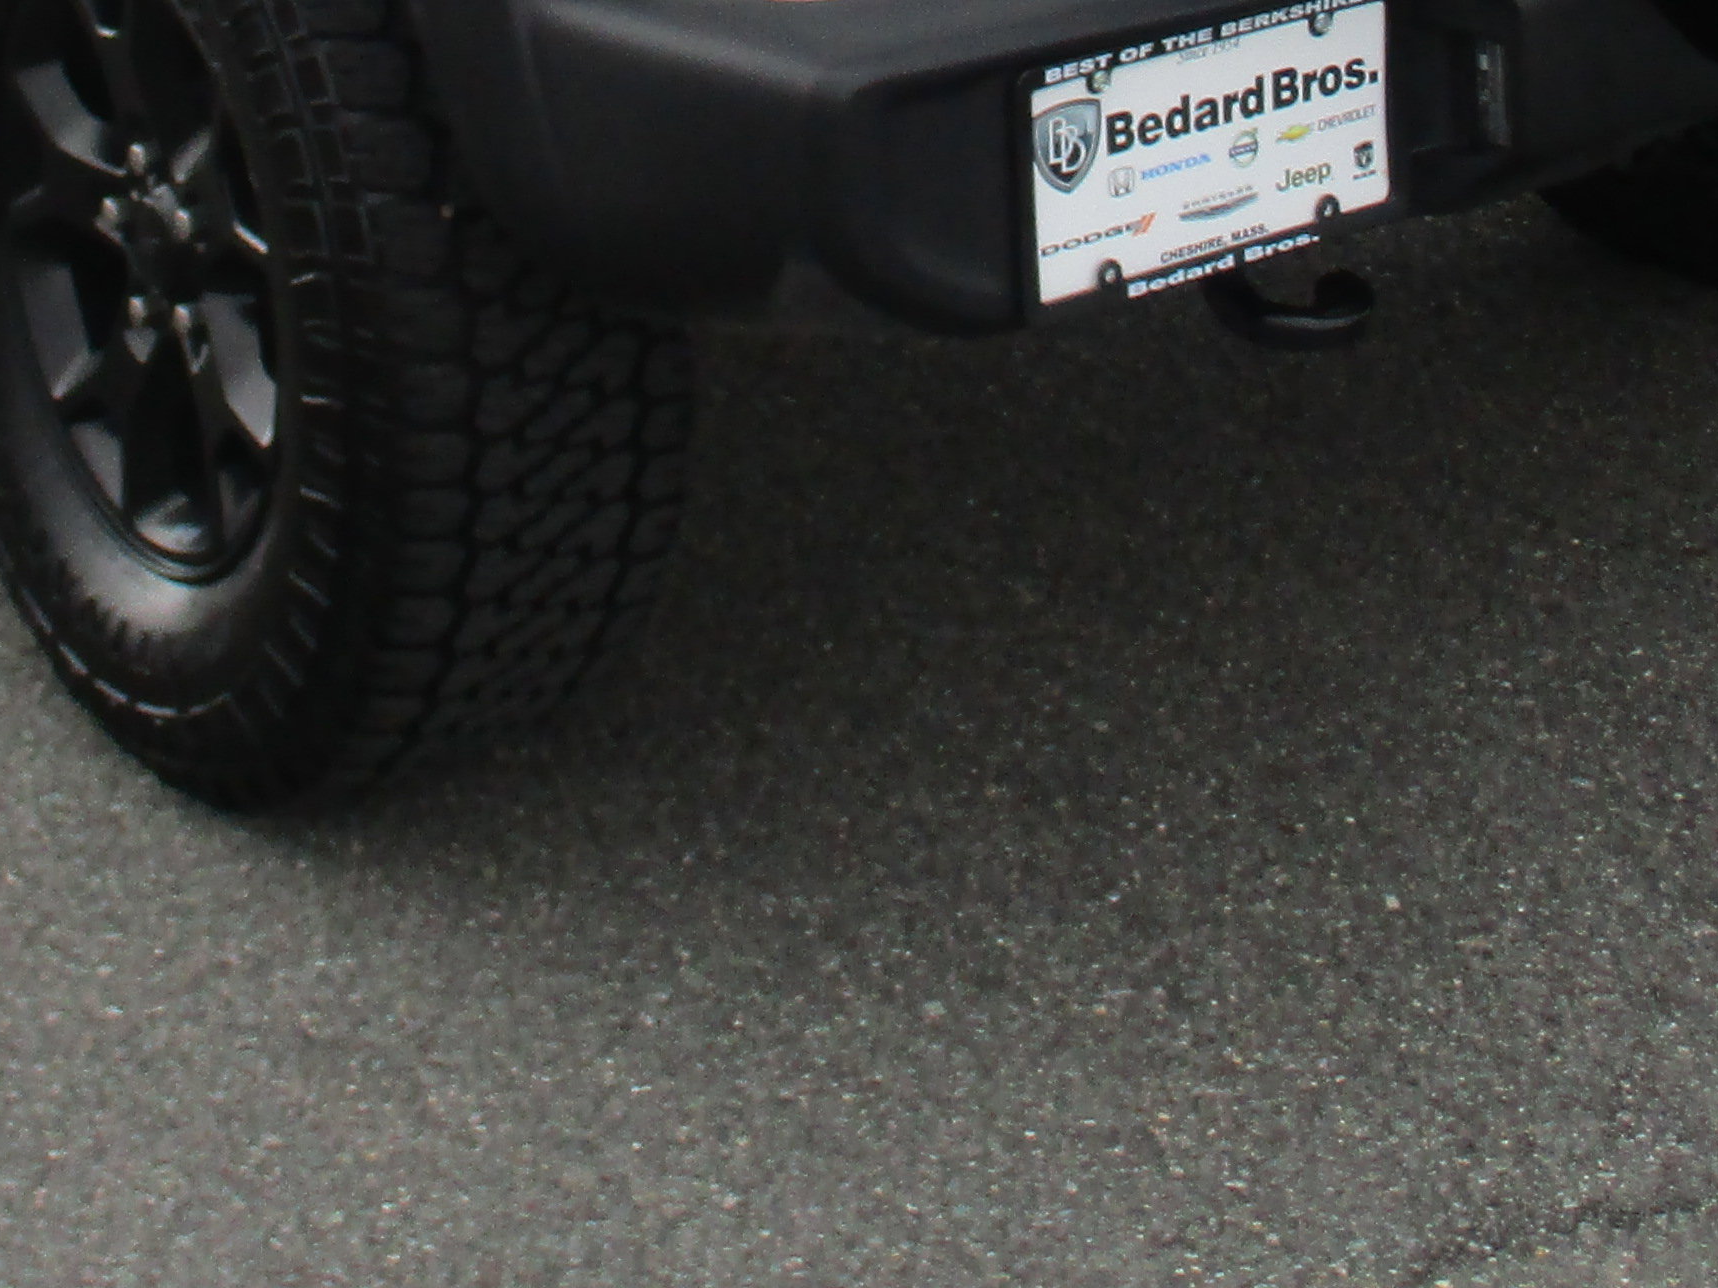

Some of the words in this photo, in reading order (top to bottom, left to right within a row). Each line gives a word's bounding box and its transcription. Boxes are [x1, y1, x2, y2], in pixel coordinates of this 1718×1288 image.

[1044, 55, 1112, 84] BEST
[1119, 41, 1153, 63] OF
[1163, 26, 1213, 53] THE
[1141, 152, 1212, 180] HONDA
[1275, 161, 1331, 193] Jeep
[1230, 223, 1269, 245] MASS.
[1127, 253, 1236, 299] Bedard
[1244, 232, 1320, 264] Bros.
